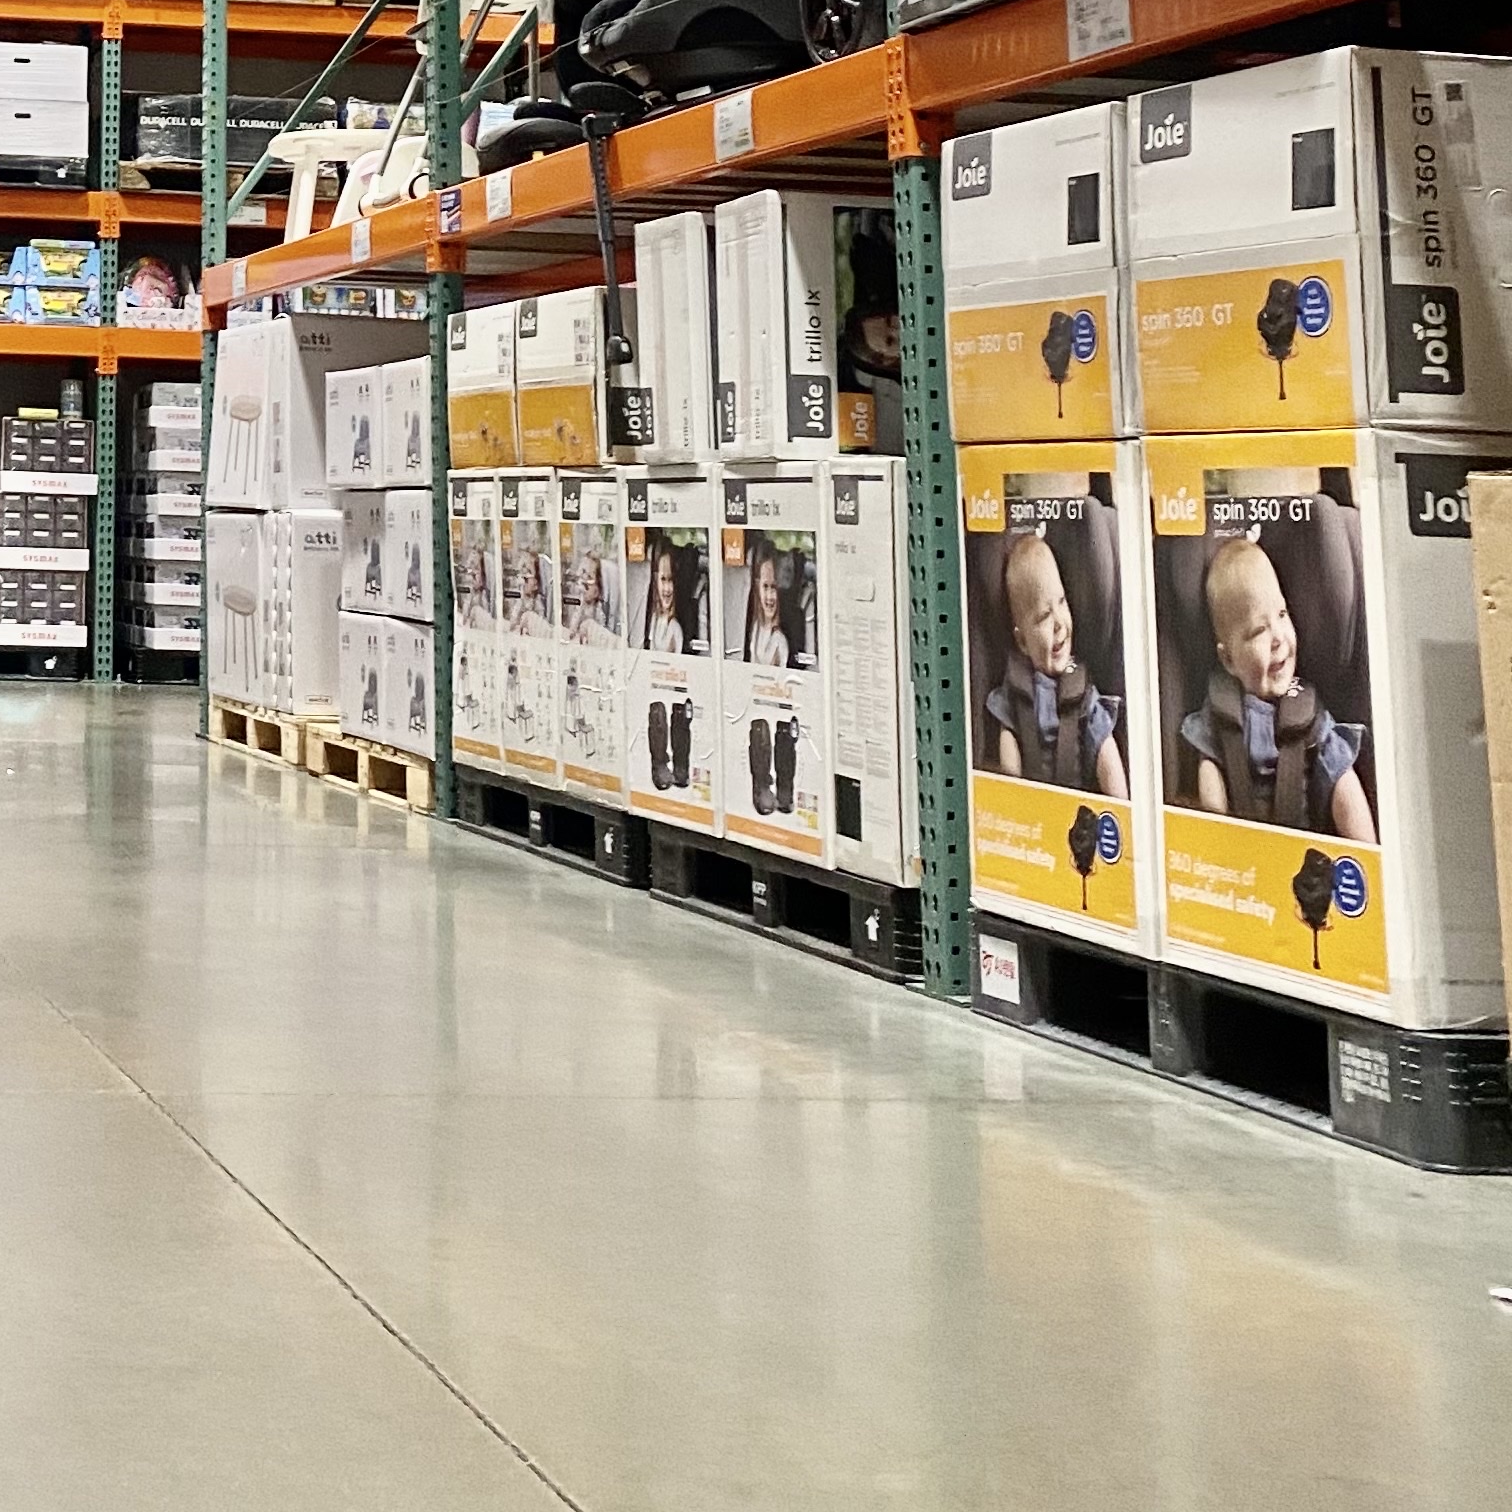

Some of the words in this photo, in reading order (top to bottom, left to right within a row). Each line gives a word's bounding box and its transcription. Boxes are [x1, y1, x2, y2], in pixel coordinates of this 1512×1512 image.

[140, 116, 188, 127] DURACELL
[1411, 85, 1434, 126] GT
[1143, 113, 1185, 152] Joie
[955, 156, 987, 190] Joie
[1414, 144, 1438, 200] 360
[1418, 210, 1445, 268] spin
[1141, 310, 1171, 335] spin
[1174, 306, 1204, 329] 360
[1212, 302, 1235, 326] GT
[805, 315, 823, 363] trillo
[1007, 331, 1025, 352] GT
[1411, 299, 1451, 383] Joie
[622, 396, 643, 440] Joie
[801, 384, 825, 432] Joie
[850, 401, 869, 442] Joie
[968, 489, 999, 520] Joie
[1010, 499, 1035, 523] spin
[1036, 499, 1061, 520] 360
[1066, 499, 1085, 520] GT
[1160, 487, 1198, 522] Joie
[1213, 498, 1244, 525] spin
[1248, 499, 1281, 522] 360
[1289, 499, 1314, 522] GT
[1419, 486, 1472, 523] Joi
[304, 531, 337, 545] atti
